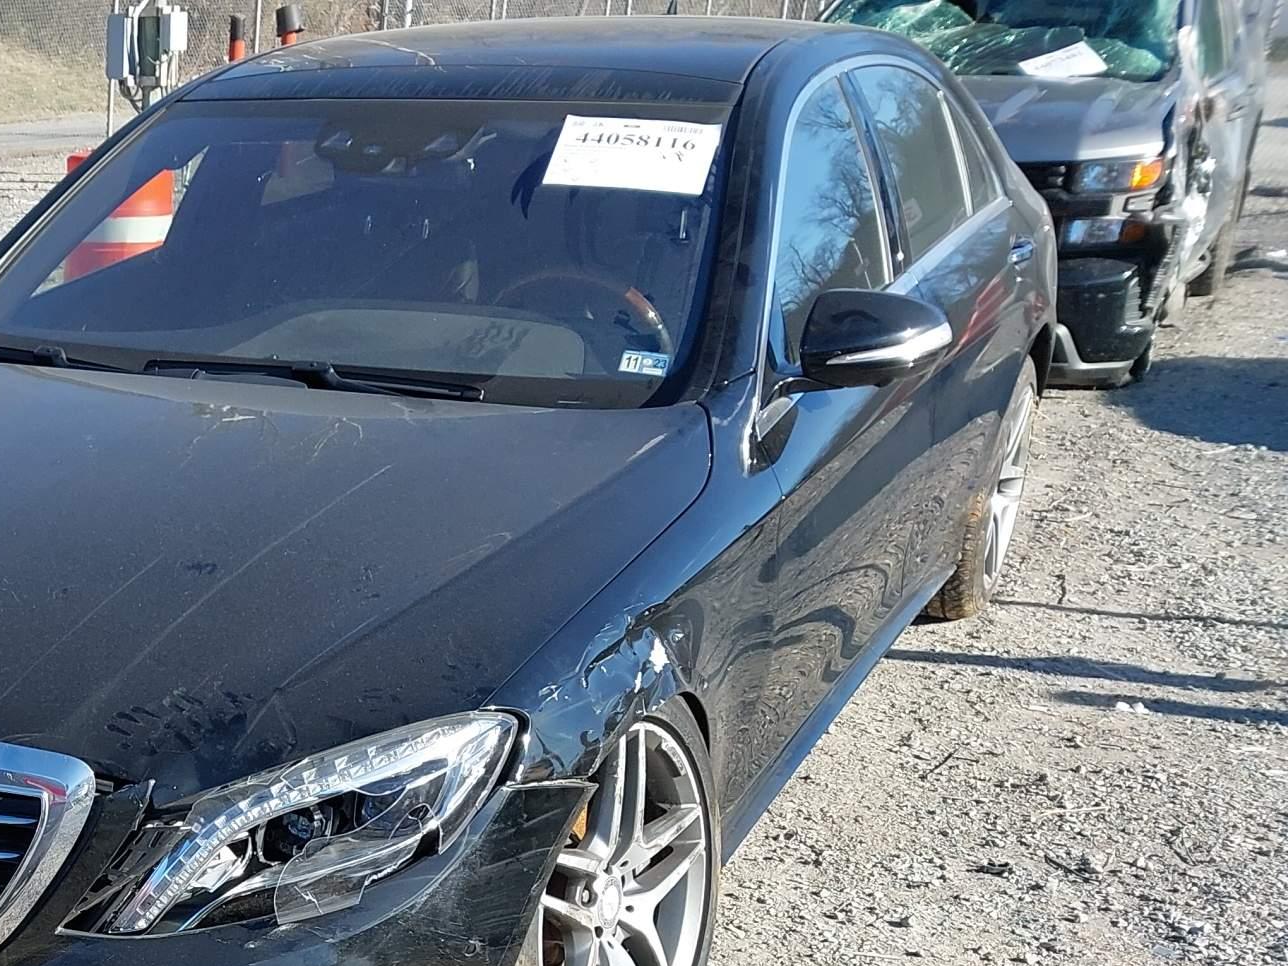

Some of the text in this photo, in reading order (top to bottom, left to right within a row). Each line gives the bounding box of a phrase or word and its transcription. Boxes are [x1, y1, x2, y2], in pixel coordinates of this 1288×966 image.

[576, 132, 696, 150] 44058116
[625, 355, 668, 369] 11 23
